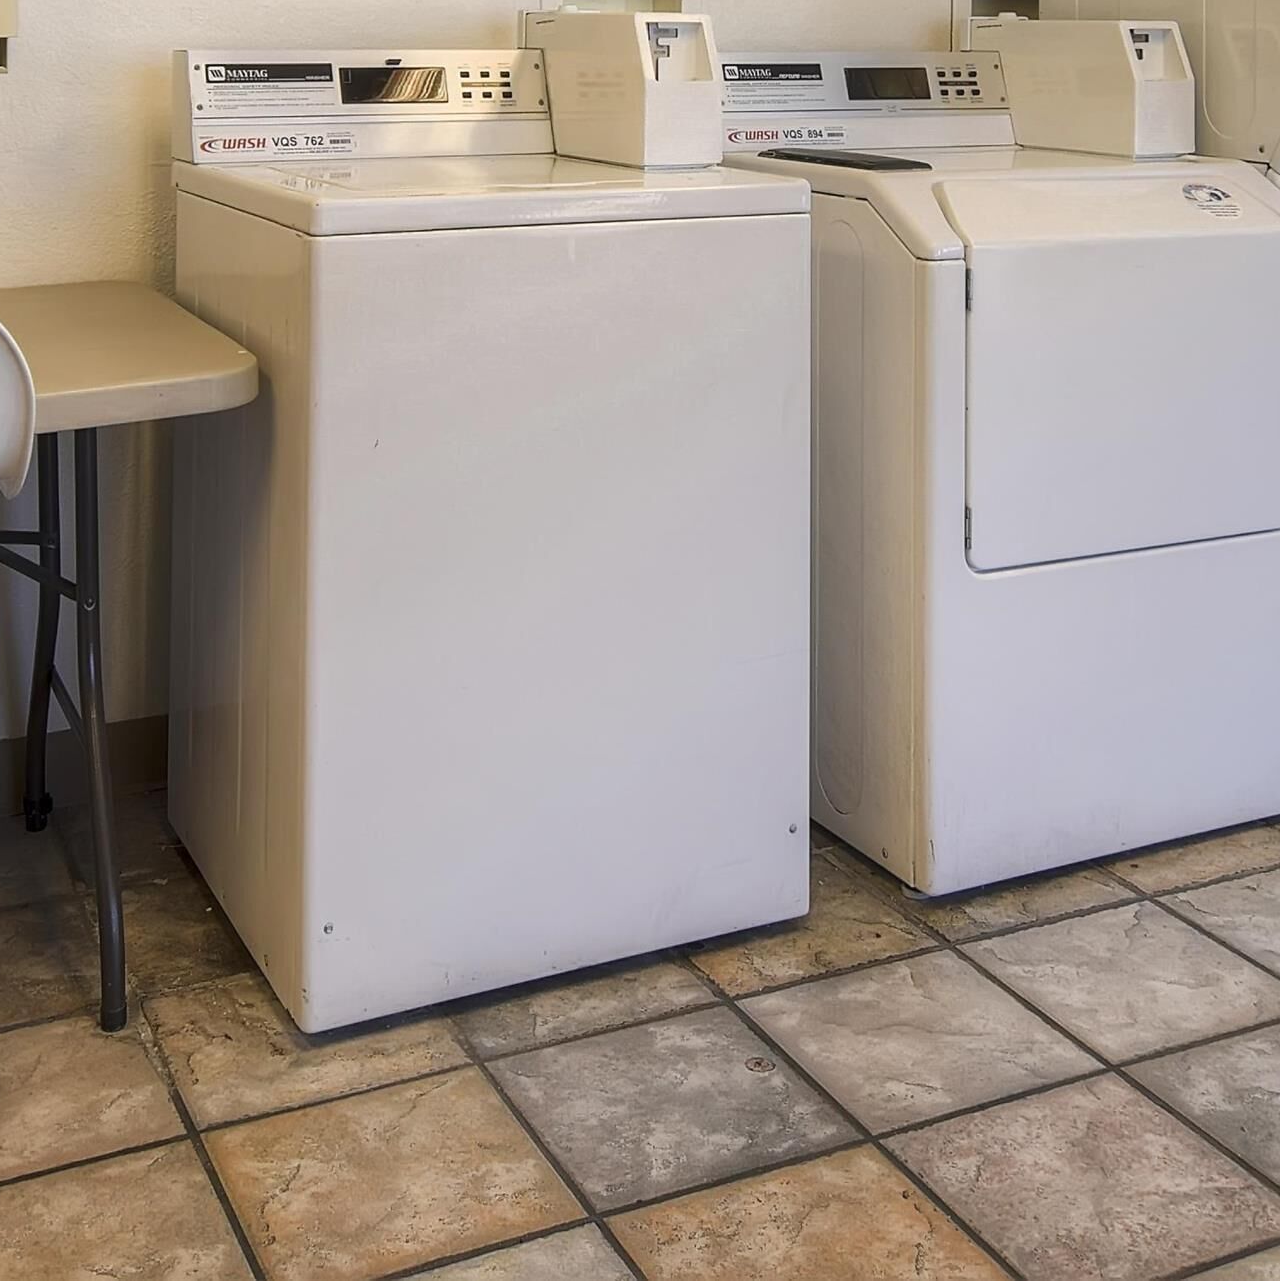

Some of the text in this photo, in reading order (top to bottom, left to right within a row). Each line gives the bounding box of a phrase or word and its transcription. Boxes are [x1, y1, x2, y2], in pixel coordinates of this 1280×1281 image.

[226, 69, 268, 78] MAYTAG
[739, 68, 772, 77] MAYTAG
[745, 130, 778, 140] WASH
[782, 129, 823, 139] VQS 894
[222, 138, 267, 149] WASH
[271, 136, 324, 147] VQS 762
